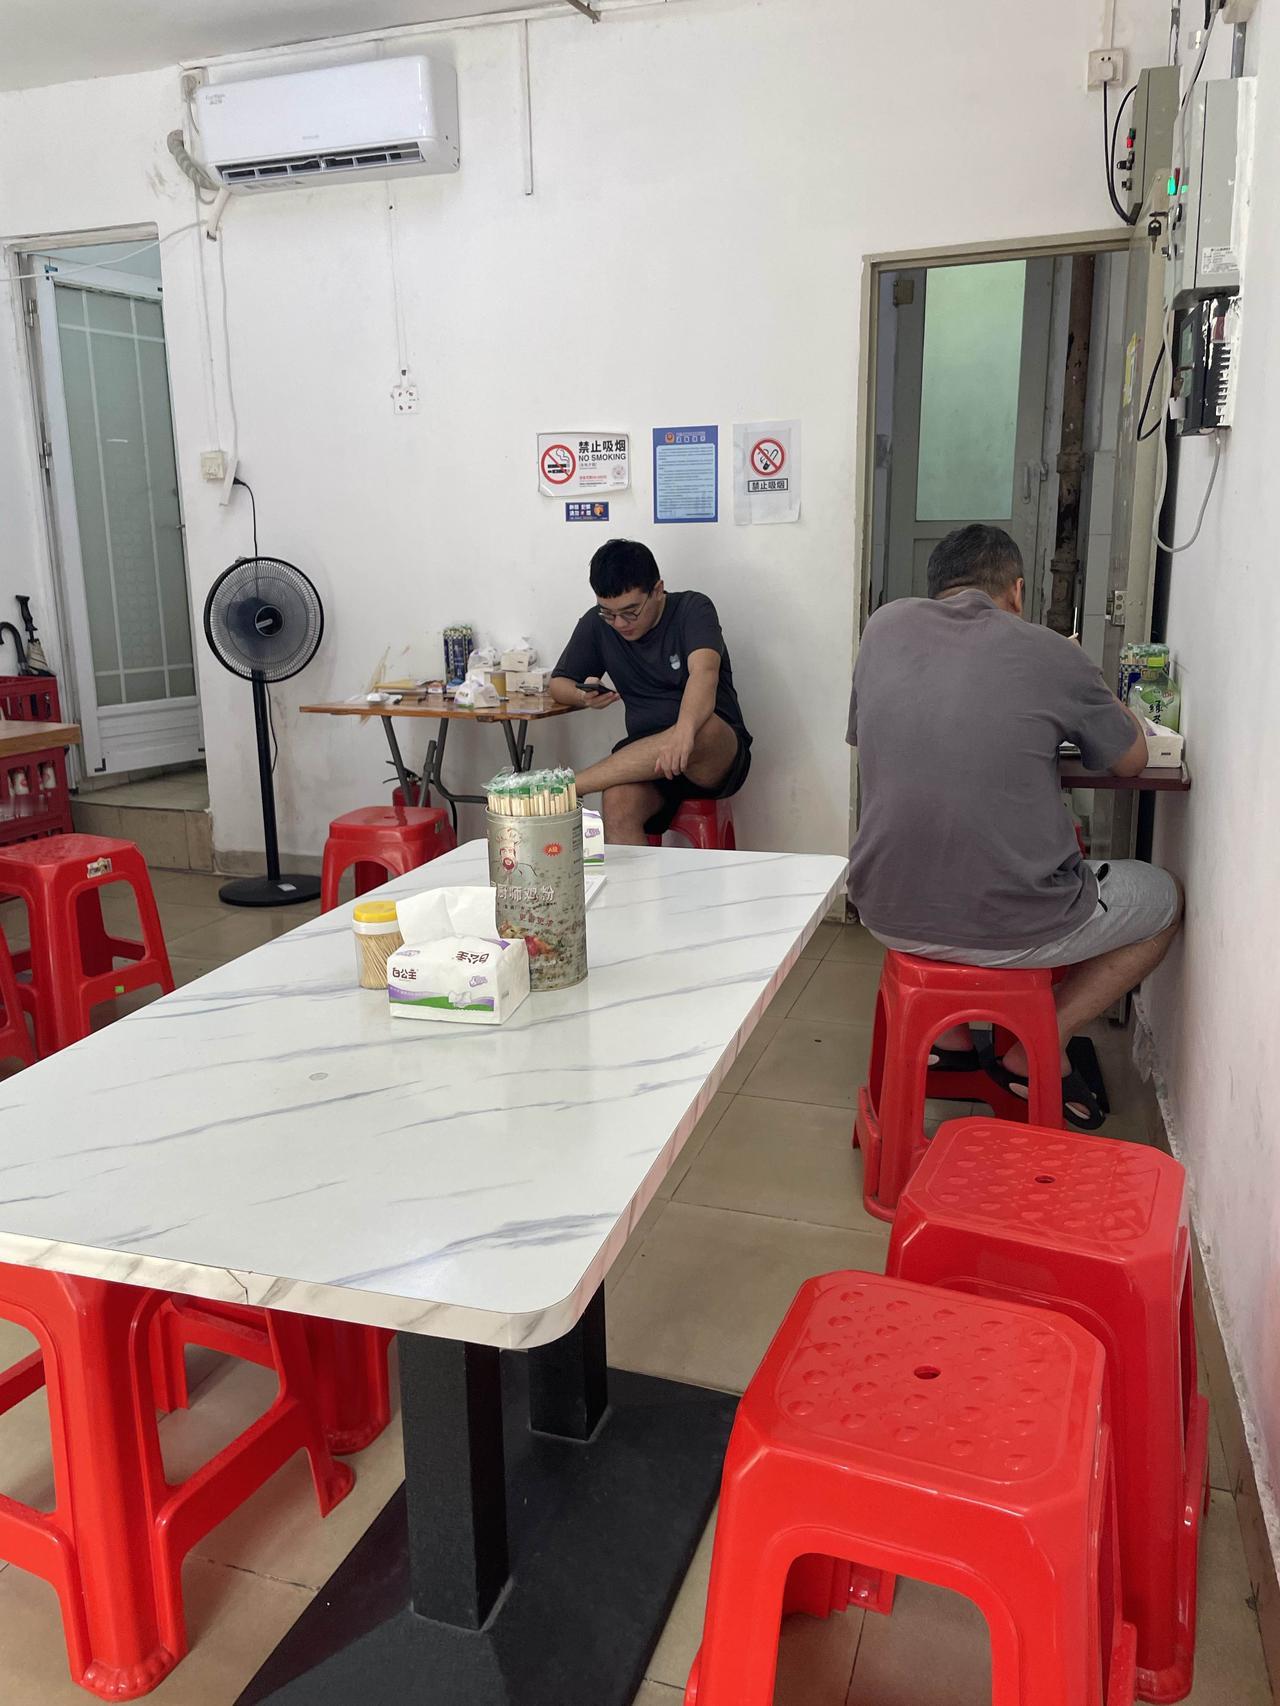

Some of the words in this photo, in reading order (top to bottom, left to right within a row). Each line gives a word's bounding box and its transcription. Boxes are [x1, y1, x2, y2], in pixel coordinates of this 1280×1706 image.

[578, 439, 626, 454] 禁止吸烟
[578, 454, 590, 462] NO
[591, 453, 626, 462] SMOKING
[752, 480, 785, 491] 禁止吸烟
[392, 967, 417, 980] 白公主
